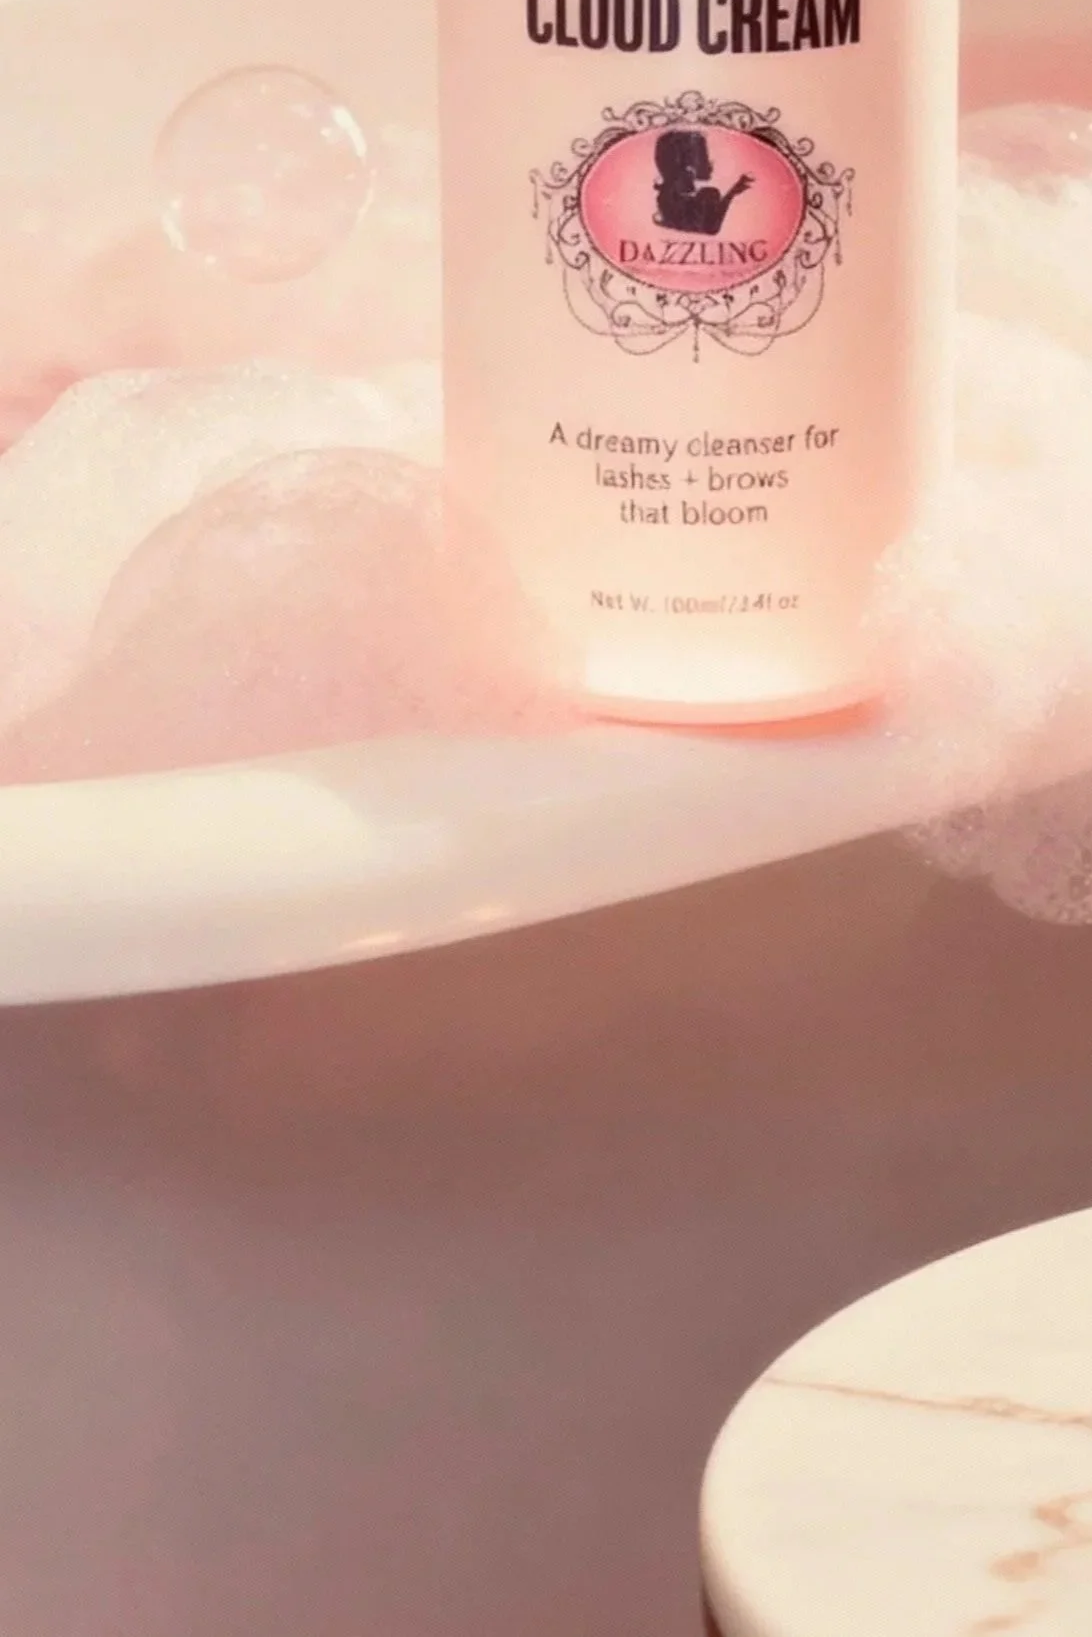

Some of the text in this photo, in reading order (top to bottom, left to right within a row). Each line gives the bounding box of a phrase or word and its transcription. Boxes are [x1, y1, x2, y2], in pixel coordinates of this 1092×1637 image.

[619, 239, 769, 264] DAZZLING
[549, 422, 840, 462] A dreamy cleanser for
[595, 462, 789, 491] lashes + brows
[620, 499, 769, 525] that bloom
[591, 590, 623, 611] Net
